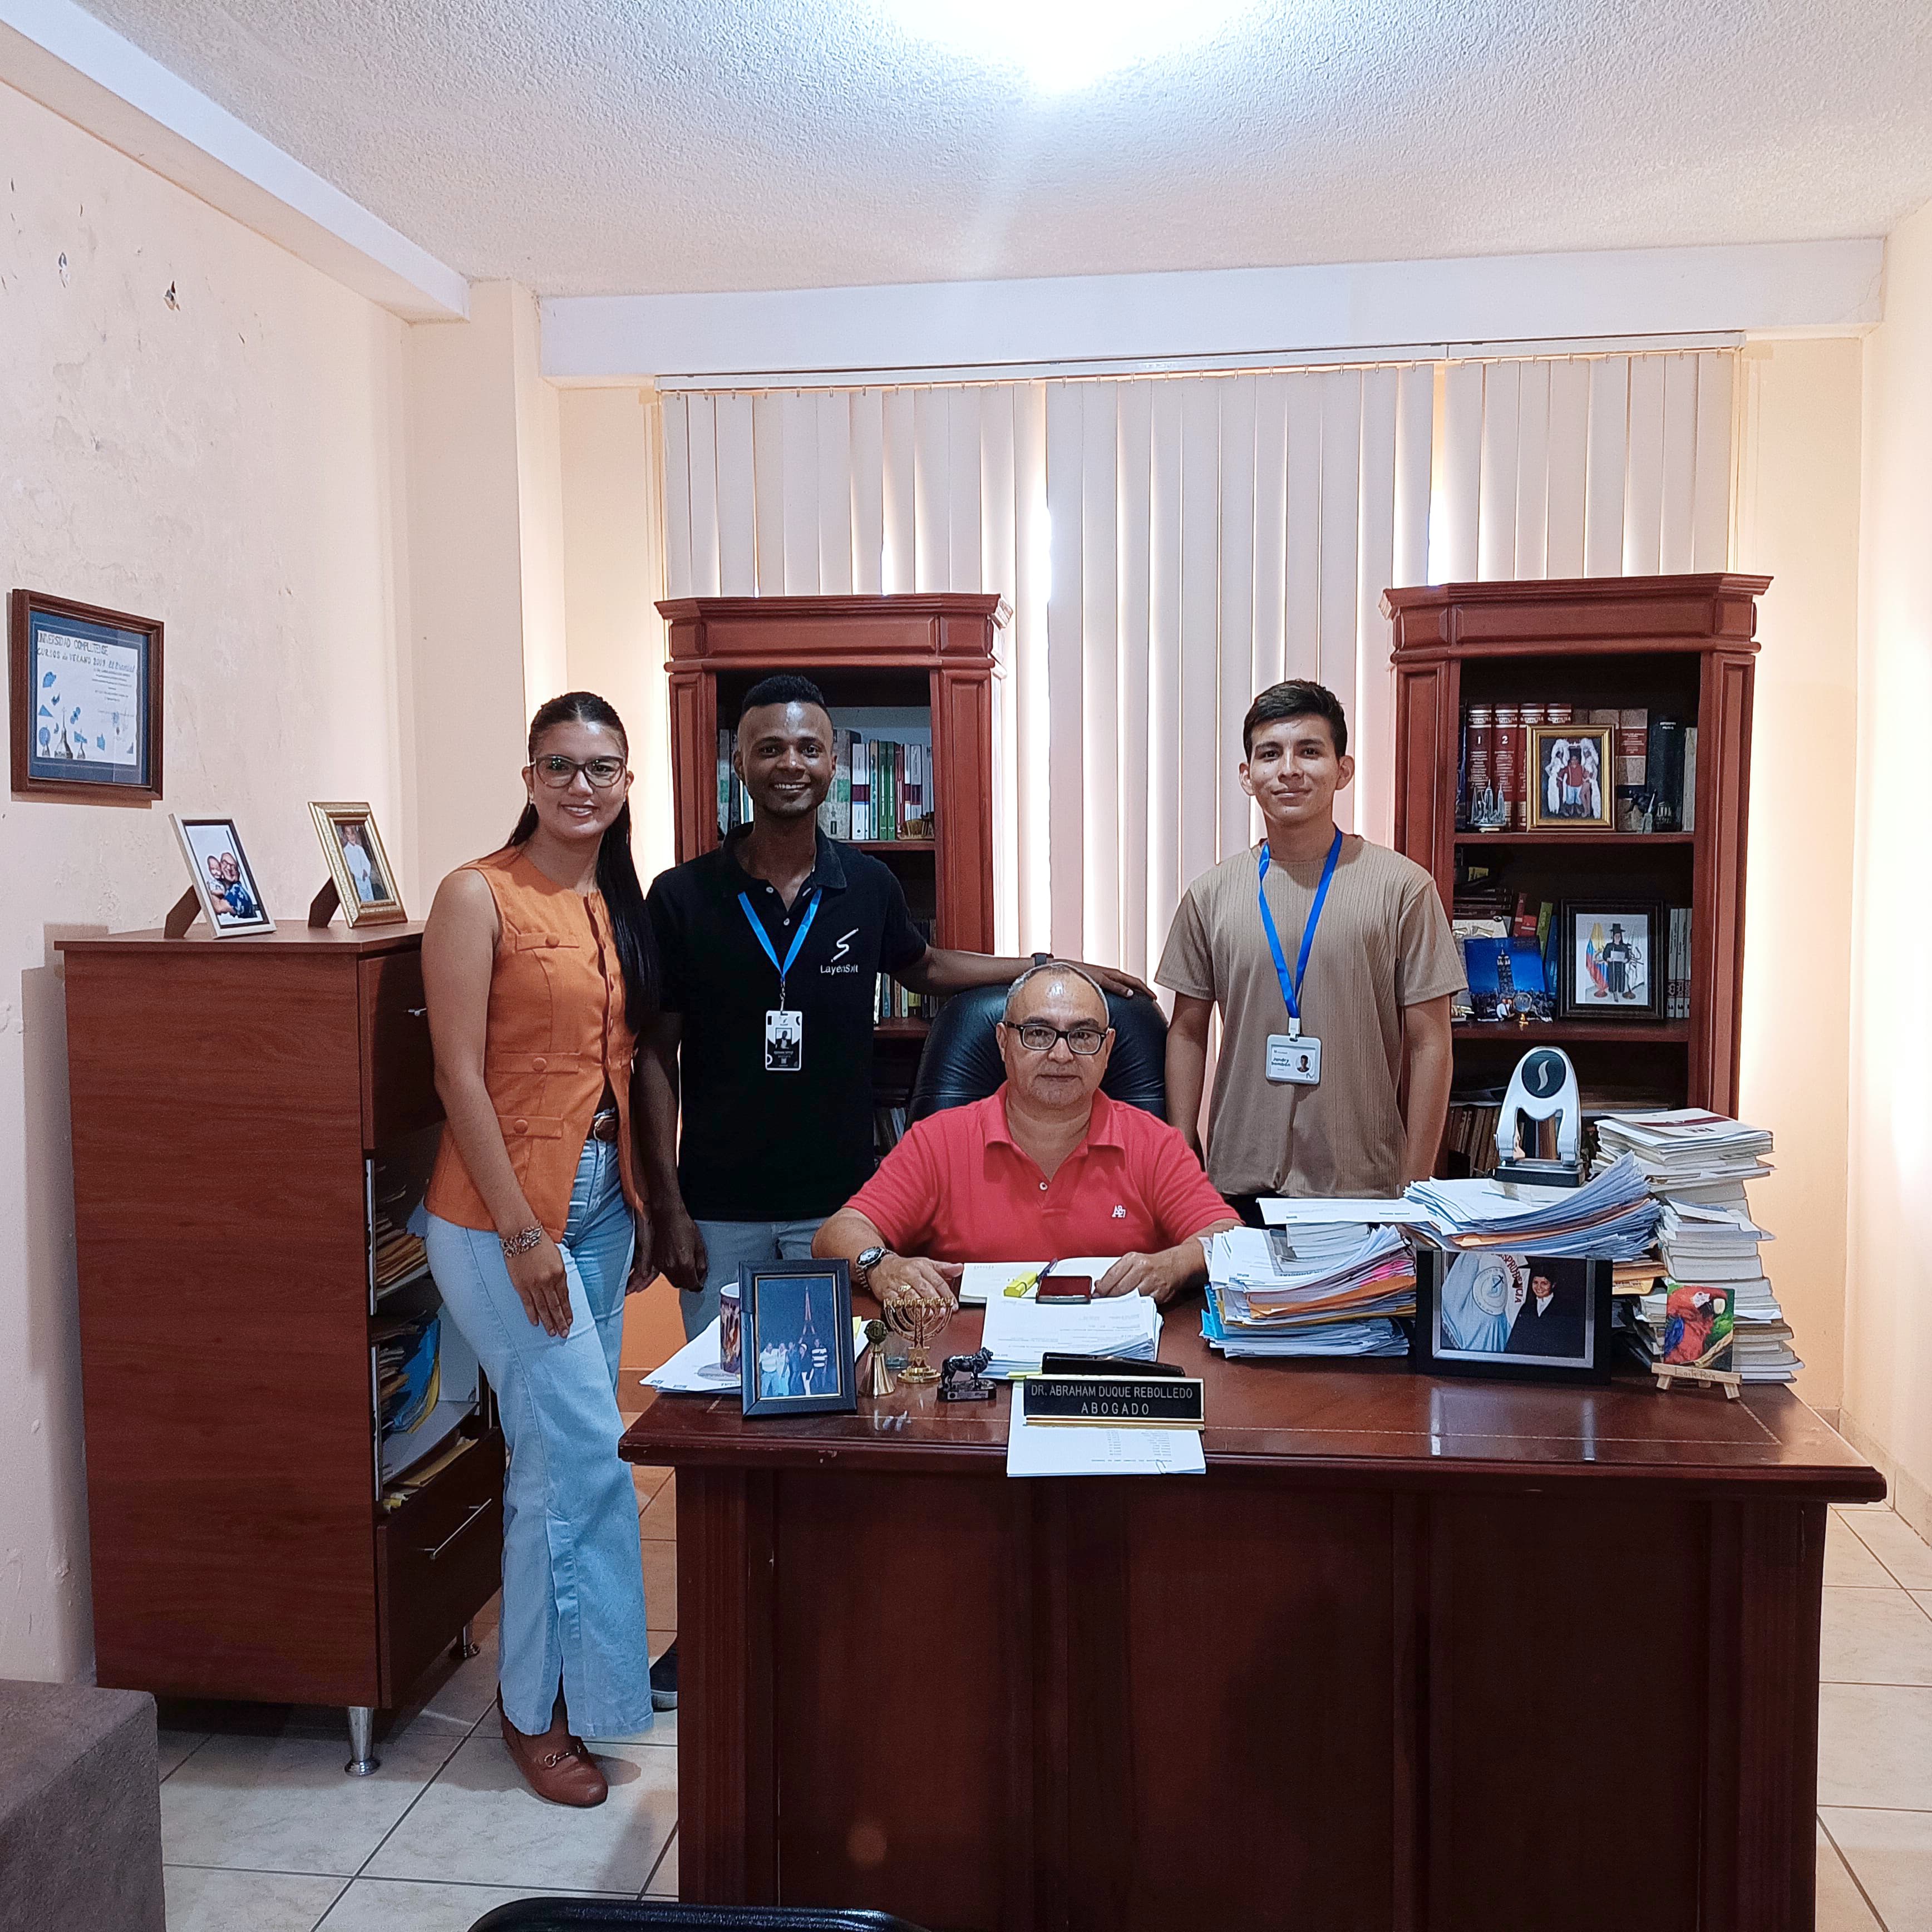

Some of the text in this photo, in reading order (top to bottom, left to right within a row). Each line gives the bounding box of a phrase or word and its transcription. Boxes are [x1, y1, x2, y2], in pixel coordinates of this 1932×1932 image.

[1477, 736, 1481, 745] 1
[1502, 735, 1509, 745] 2
[1031, 1384, 1193, 1399] DR. ABRAHAM DUQUE REBOLLEDO
[1081, 1402, 1149, 1415] ABOGADO
